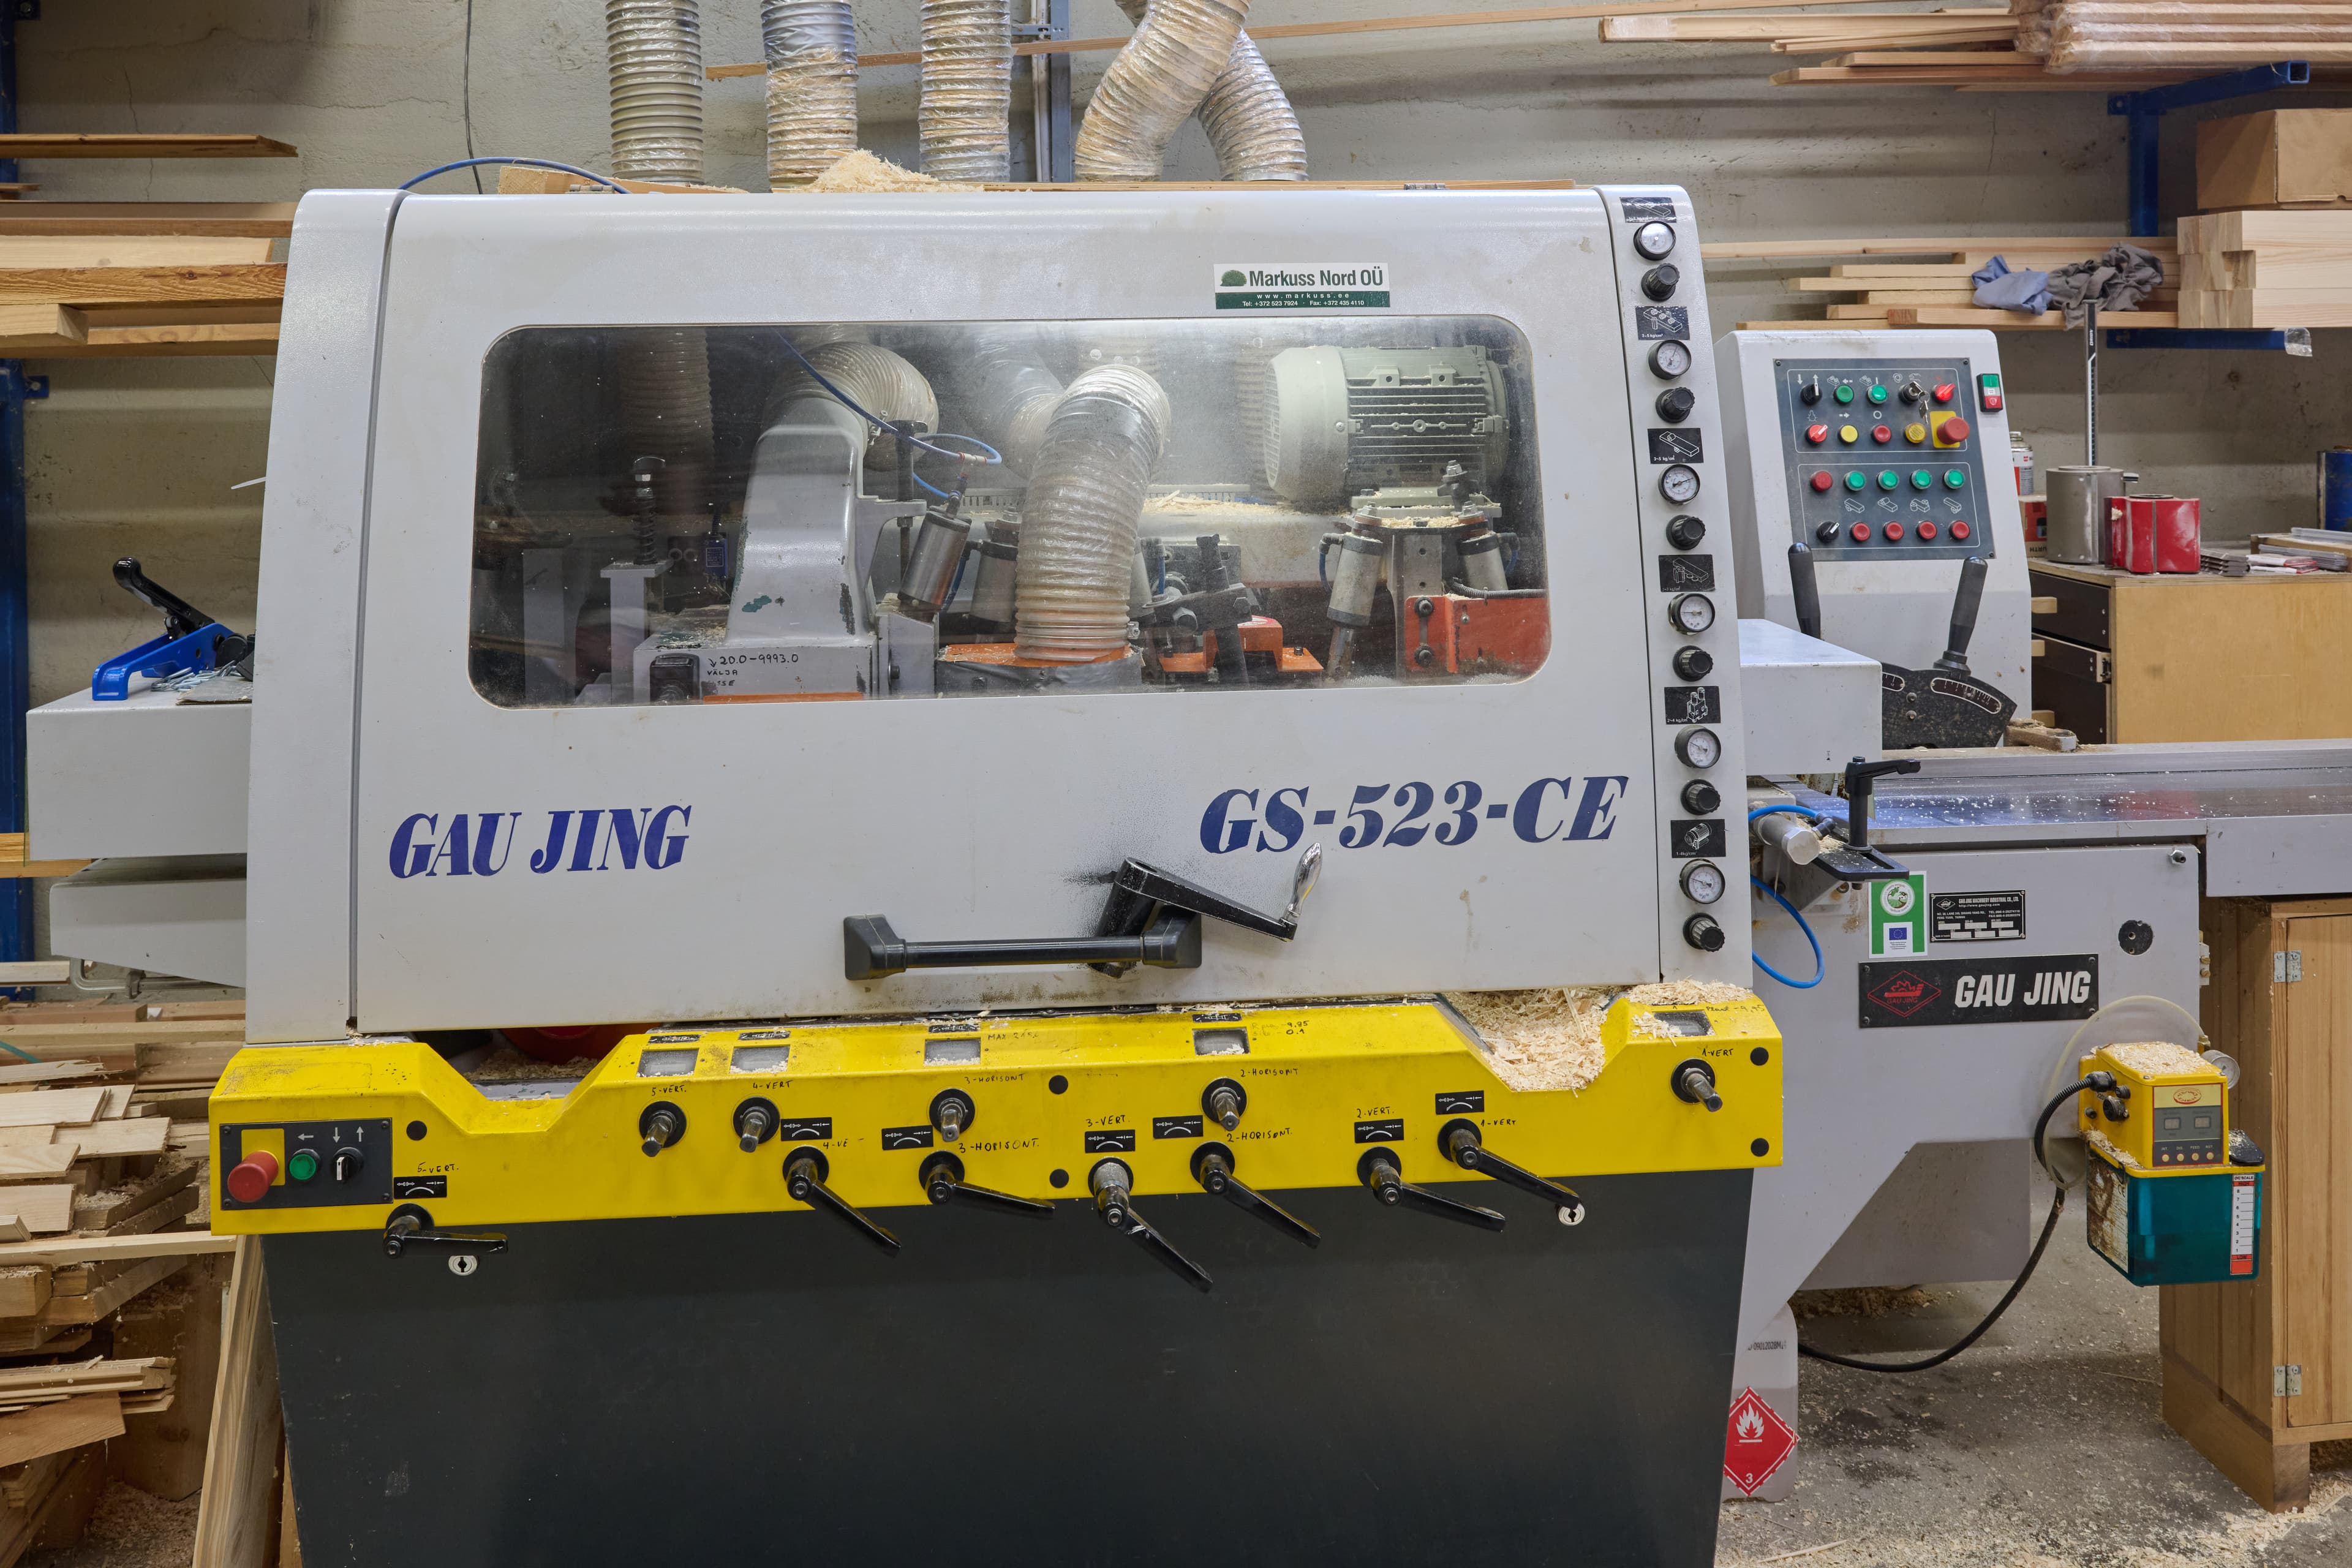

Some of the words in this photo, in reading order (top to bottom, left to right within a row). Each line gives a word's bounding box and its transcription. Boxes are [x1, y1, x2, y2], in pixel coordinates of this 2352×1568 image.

[1249, 270, 1316, 287] Markuss
[1320, 269, 1356, 286] Nord
[1360, 266, 1383, 285] OÜ
[1200, 775, 1629, 854] GS-523-CE
[389, 812, 522, 878] GAU
[530, 805, 692, 874] JING
[1954, 974, 2016, 1008] GAU
[2024, 971, 2091, 1005] JING
[753, 1080, 793, 1090] 4-VERT
[1746, 1472, 1754, 1483] 3
